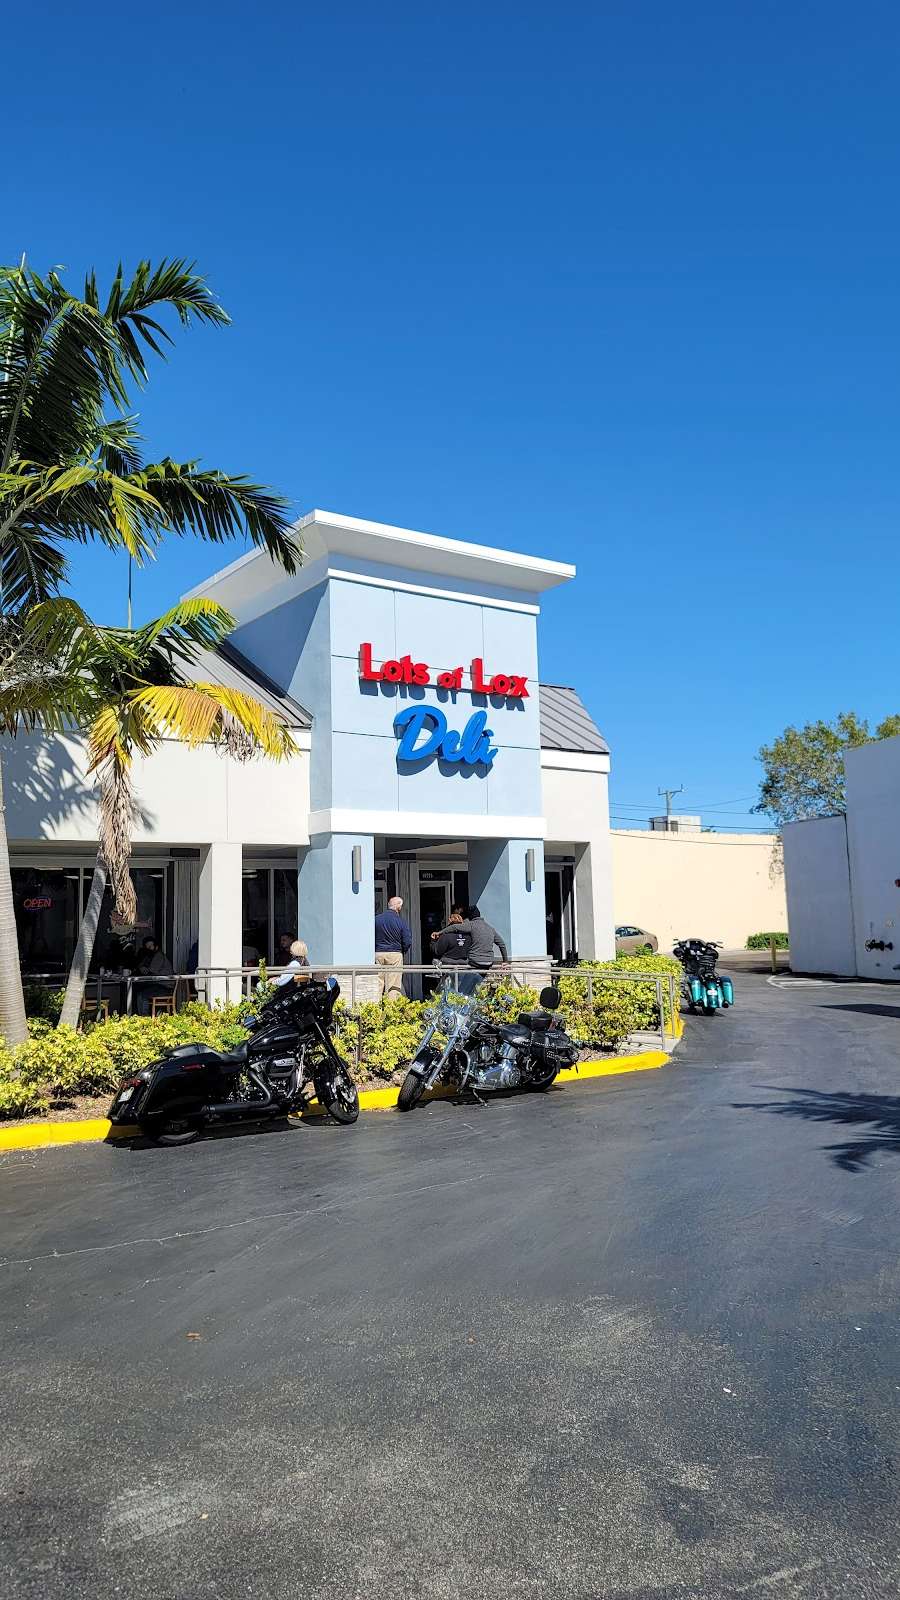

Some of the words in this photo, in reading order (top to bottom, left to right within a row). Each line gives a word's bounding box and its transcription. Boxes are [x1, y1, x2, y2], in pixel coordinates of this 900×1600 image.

[360, 643, 430, 685] Lots
[437, 666, 463, 689] of
[472, 657, 530, 698] Lox
[394, 704, 498, 764] Deli
[23, 898, 51, 908] OPEN
